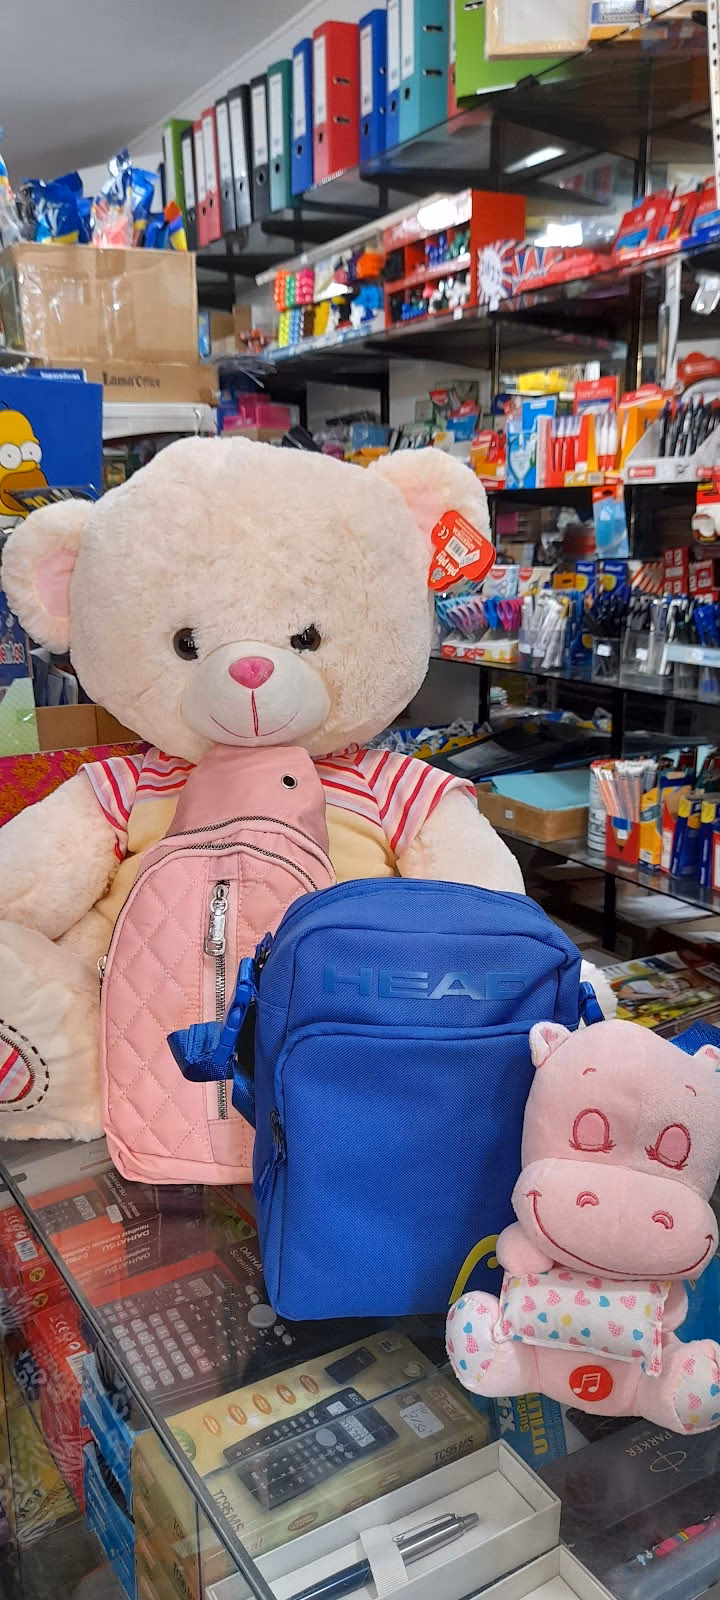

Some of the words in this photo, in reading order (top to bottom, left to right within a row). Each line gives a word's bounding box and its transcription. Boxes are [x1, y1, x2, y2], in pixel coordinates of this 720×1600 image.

[324, 963, 536, 1001] HEAD
[102, 1229, 150, 1253] DAIHATSU
[104, 1252, 151, 1276] DAIHATSU
[230, 1249, 256, 1277] Scientific
[240, 1246, 265, 1275] DAIHA
[348, 1393, 362, 1405] Eca
[625, 1430, 673, 1457] PARKER
